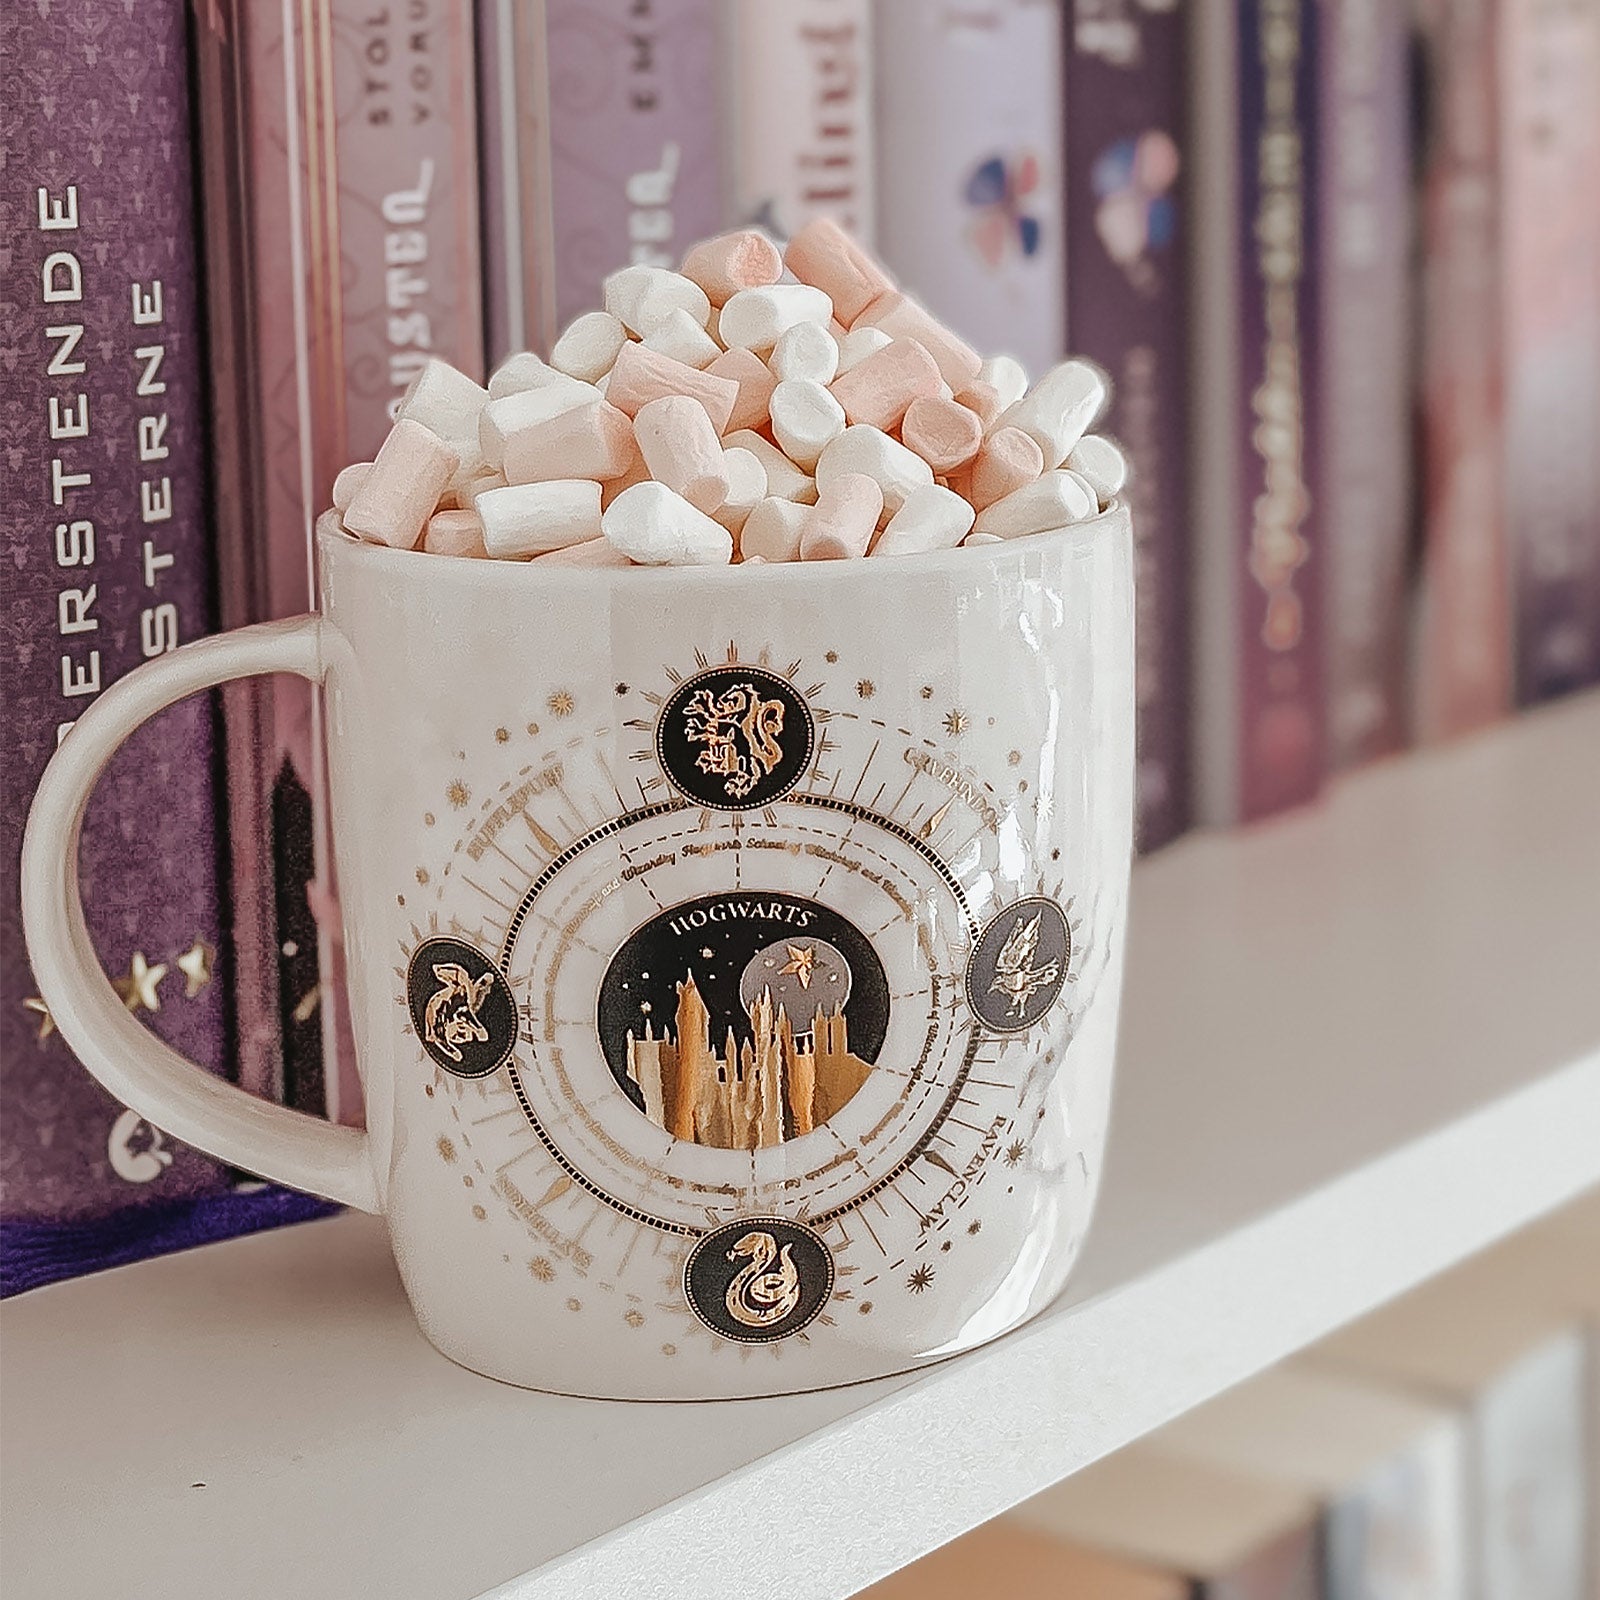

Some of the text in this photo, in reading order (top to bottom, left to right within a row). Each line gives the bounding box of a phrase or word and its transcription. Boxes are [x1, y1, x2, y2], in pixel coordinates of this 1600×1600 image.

[38, 184, 101, 738] ERSTENDE
[131, 280, 179, 657] STERNE
[668, 901, 818, 937] HOGWARTS
[917, 1115, 1008, 1238] RAVENCLAW
